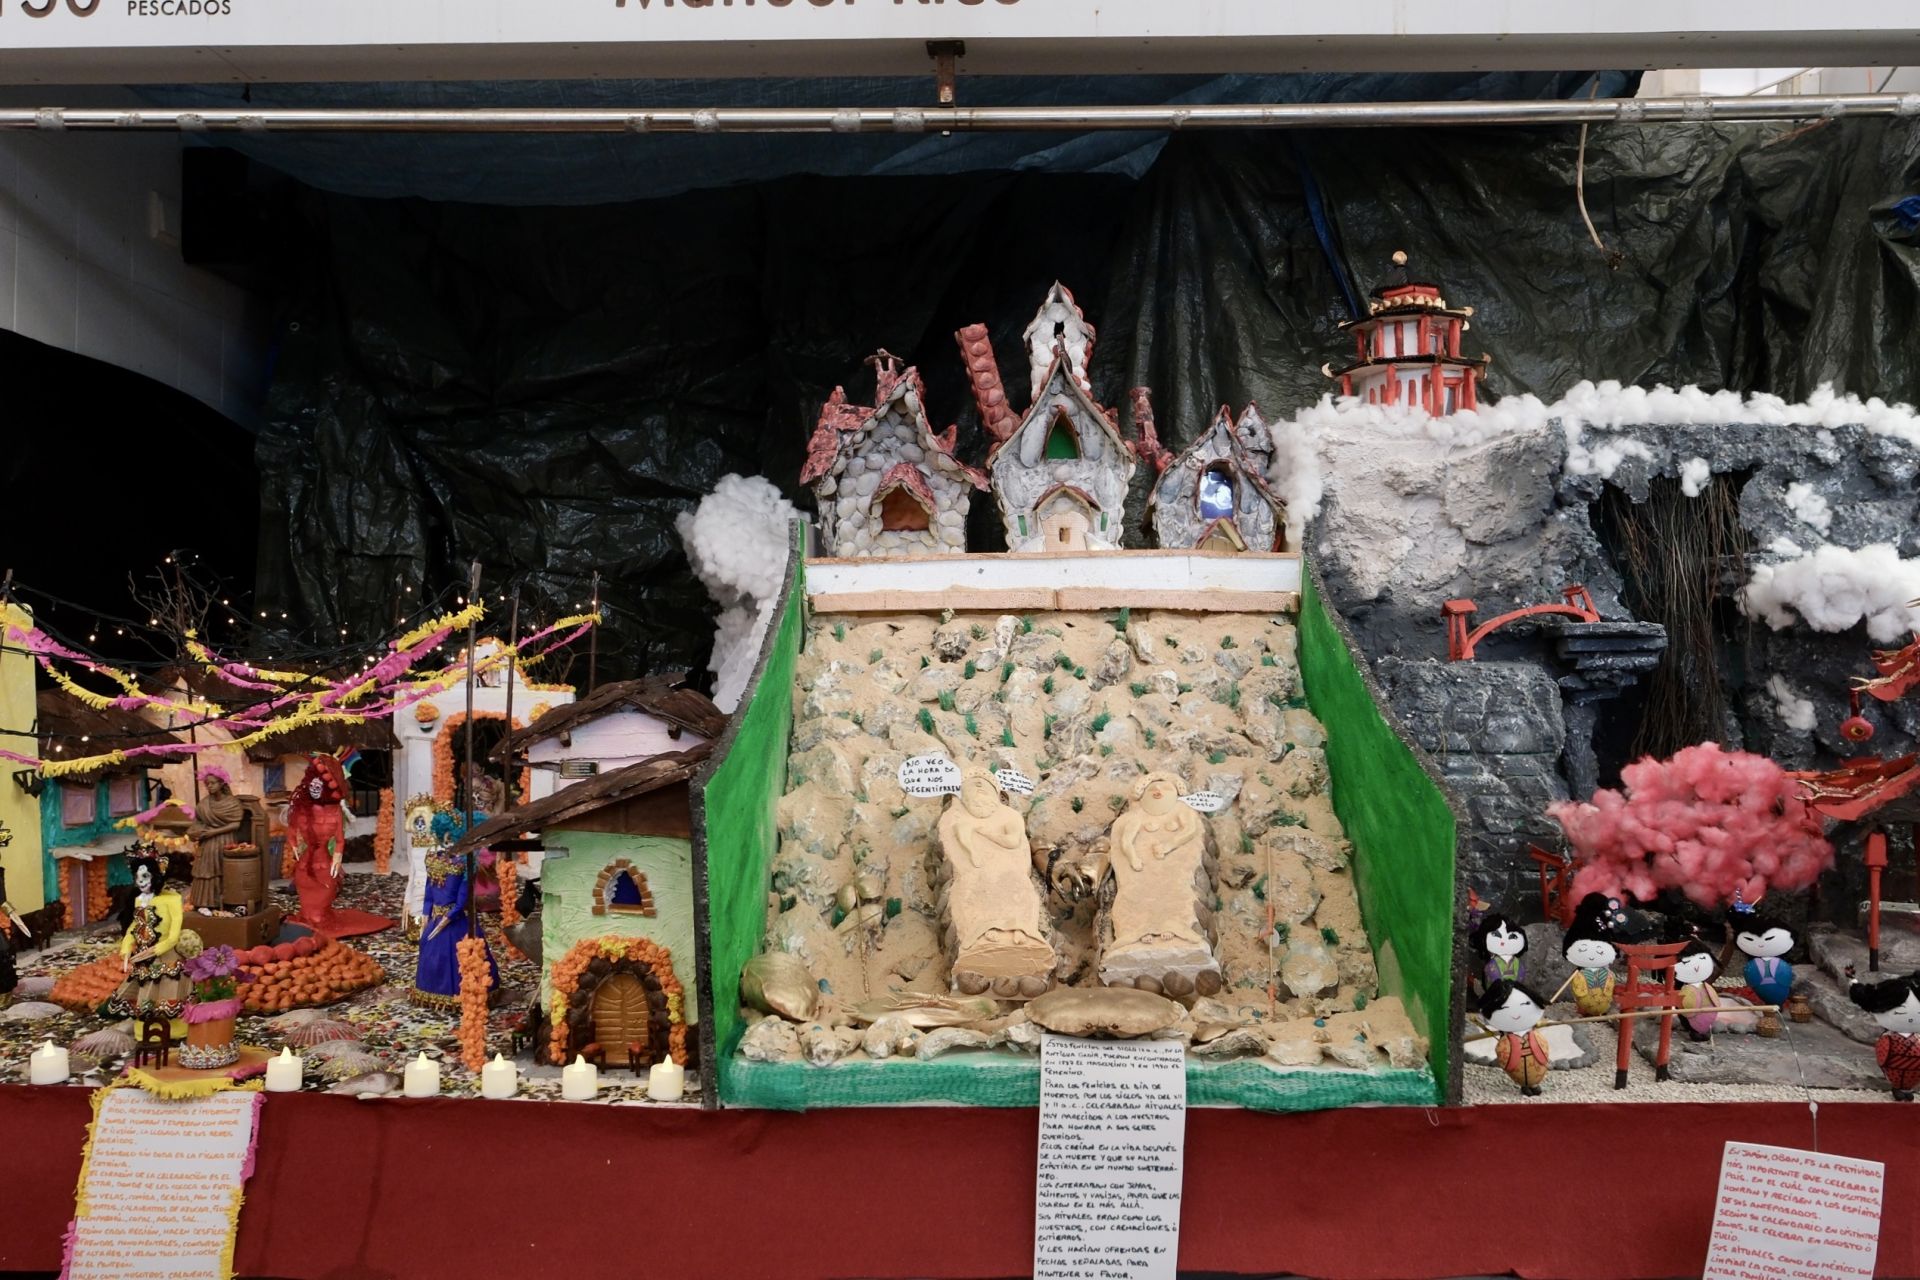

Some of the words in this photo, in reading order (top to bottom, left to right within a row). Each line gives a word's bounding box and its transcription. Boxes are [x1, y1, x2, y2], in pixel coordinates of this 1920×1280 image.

[127, 0, 232, 16] PESCADOS
[1044, 1092, 1080, 1100] MUERTOS
[1747, 1165, 1800, 1178] IMPORTANTE
[1802, 1174, 1822, 1183] QUE
[1824, 1178, 1866, 1192] CELEBRA
[1767, 1179, 1776, 1187] EL
[1808, 1186, 1830, 1196] COMO
[1722, 1196, 1733, 1204] DE
[1734, 1199, 1747, 1207] SUS
[1724, 1184, 1760, 1196] HONRAN
[1763, 1190, 1768, 1198] Y
[1771, 1192, 1812, 1204] RECIBEN
[1824, 1201, 1840, 1209] LOS
[1761, 1215, 1822, 1232] CALENDARIO
[1825, 1226, 1838, 1234] EN
[1748, 1225, 1759, 1233] SE
[1762, 1228, 1804, 1242] CELEBRA
[1808, 1236, 1821, 1244] EN
[1823, 1239, 1863, 1251] AGOSTO
[1037, 1258, 1068, 1266] FECHAS
[1712, 1243, 1727, 1252] SUS
[1731, 1246, 1775, 1260] RITUALES
[1778, 1256, 1803, 1265] COMO
[1806, 1260, 1819, 1268] EN
[1707, 1266, 1736, 1277] ALTAR
[1748, 1262, 1760, 1270] LA
[1792, 1270, 1832, 1280] COLOCAR
